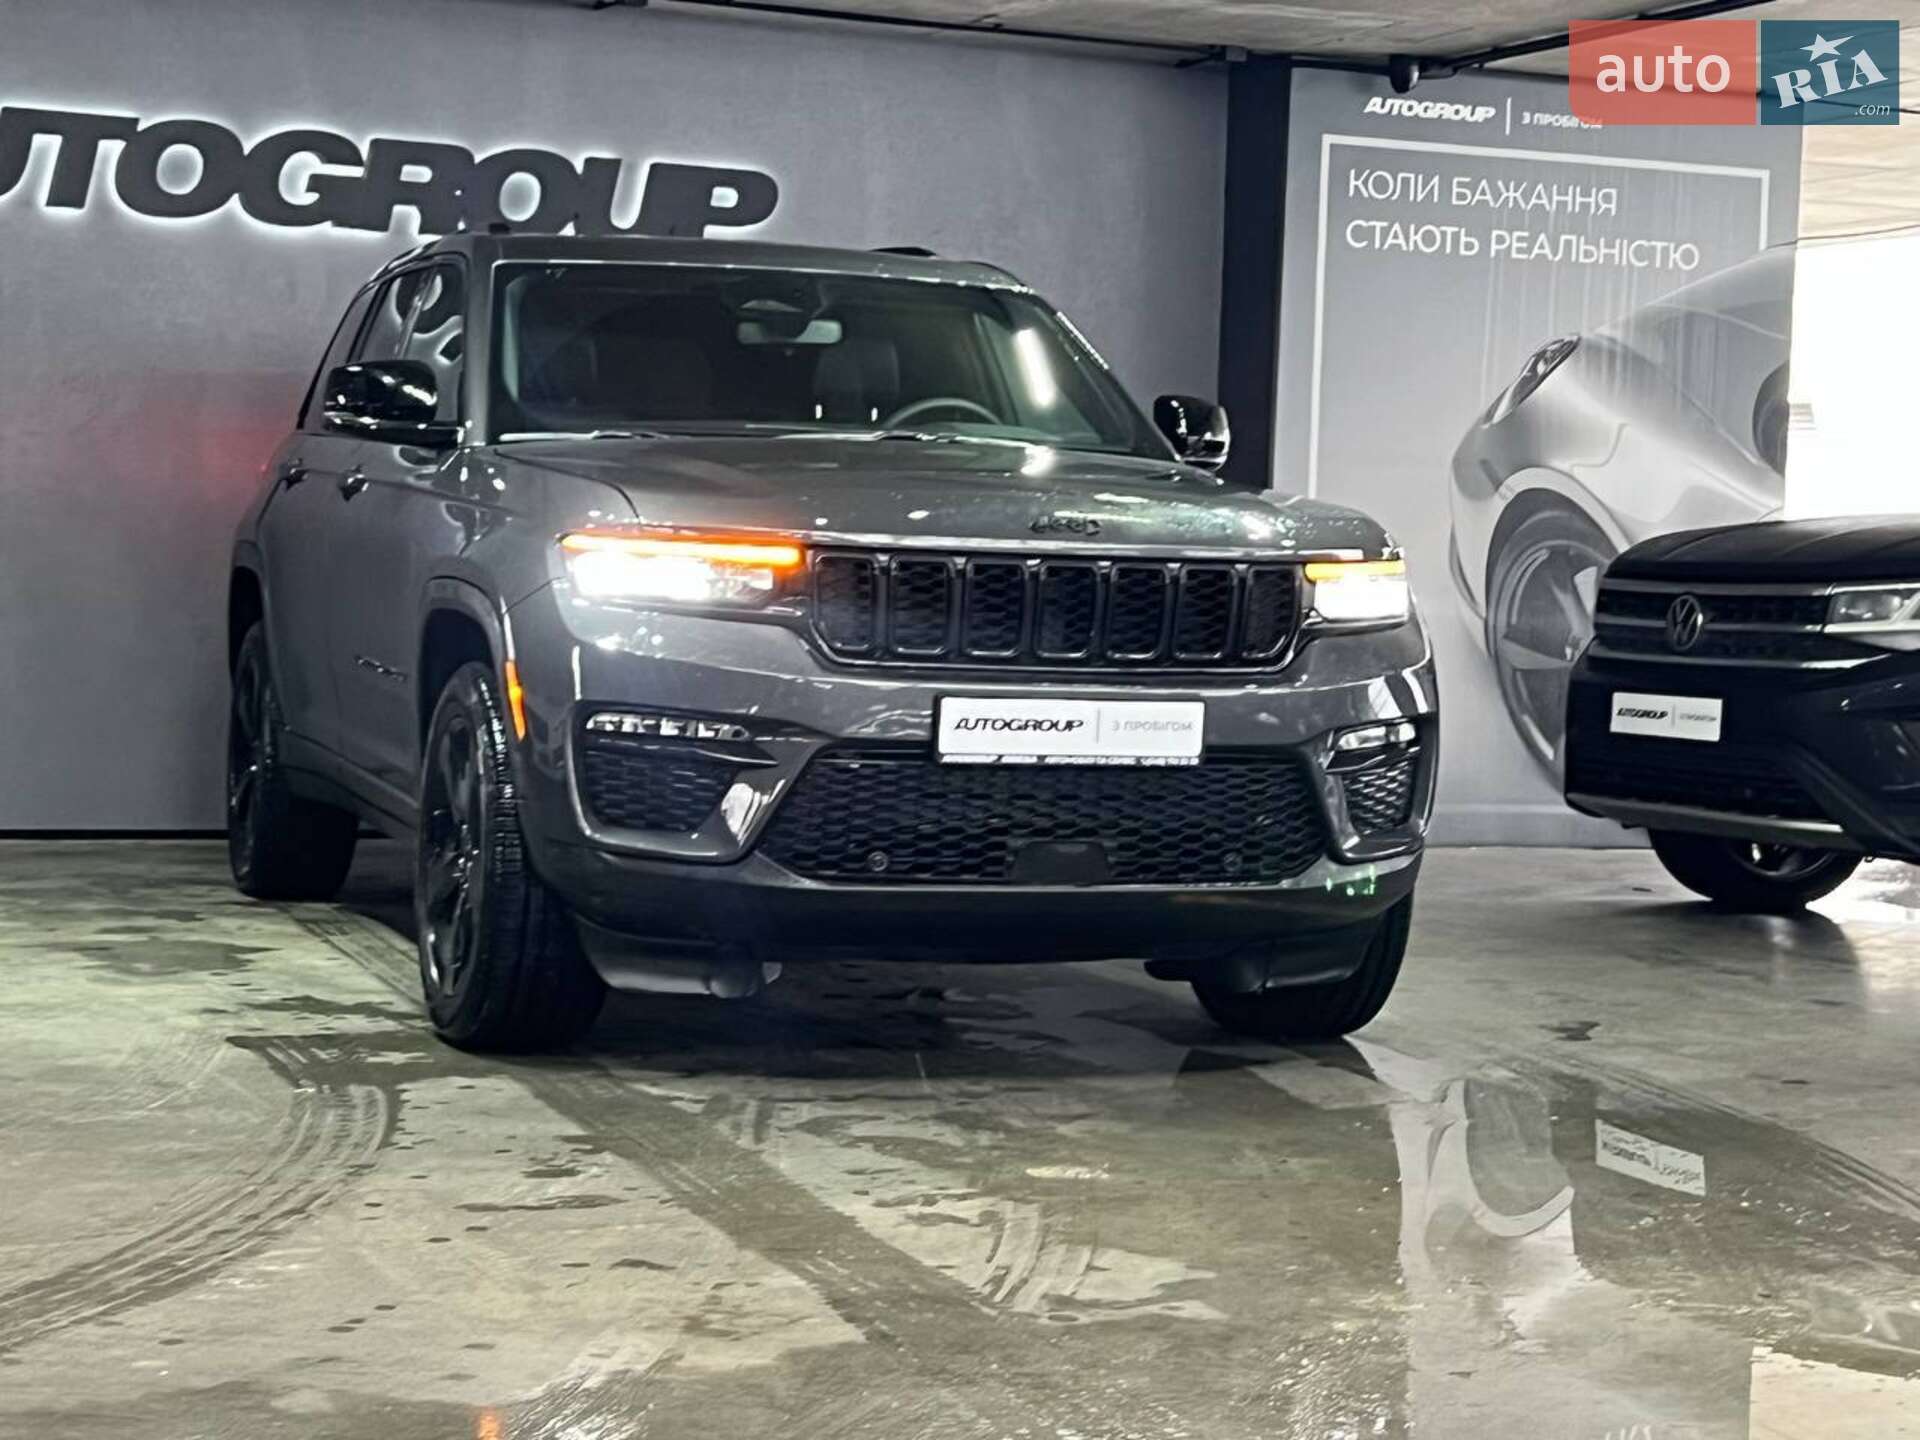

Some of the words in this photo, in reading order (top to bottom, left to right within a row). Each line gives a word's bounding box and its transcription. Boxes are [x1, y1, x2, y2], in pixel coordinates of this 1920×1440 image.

[1363, 96, 1497, 123] AUTOGROUP
[1348, 168, 1440, 203] КОЛИ
[1450, 176, 1619, 217] БАЖАННЯ
[1345, 219, 1480, 256] СТАЮТЬ
[1489, 229, 1701, 271] РЕАЛЬНІСТЮ
[953, 717, 1085, 732] AUTOGROUP
